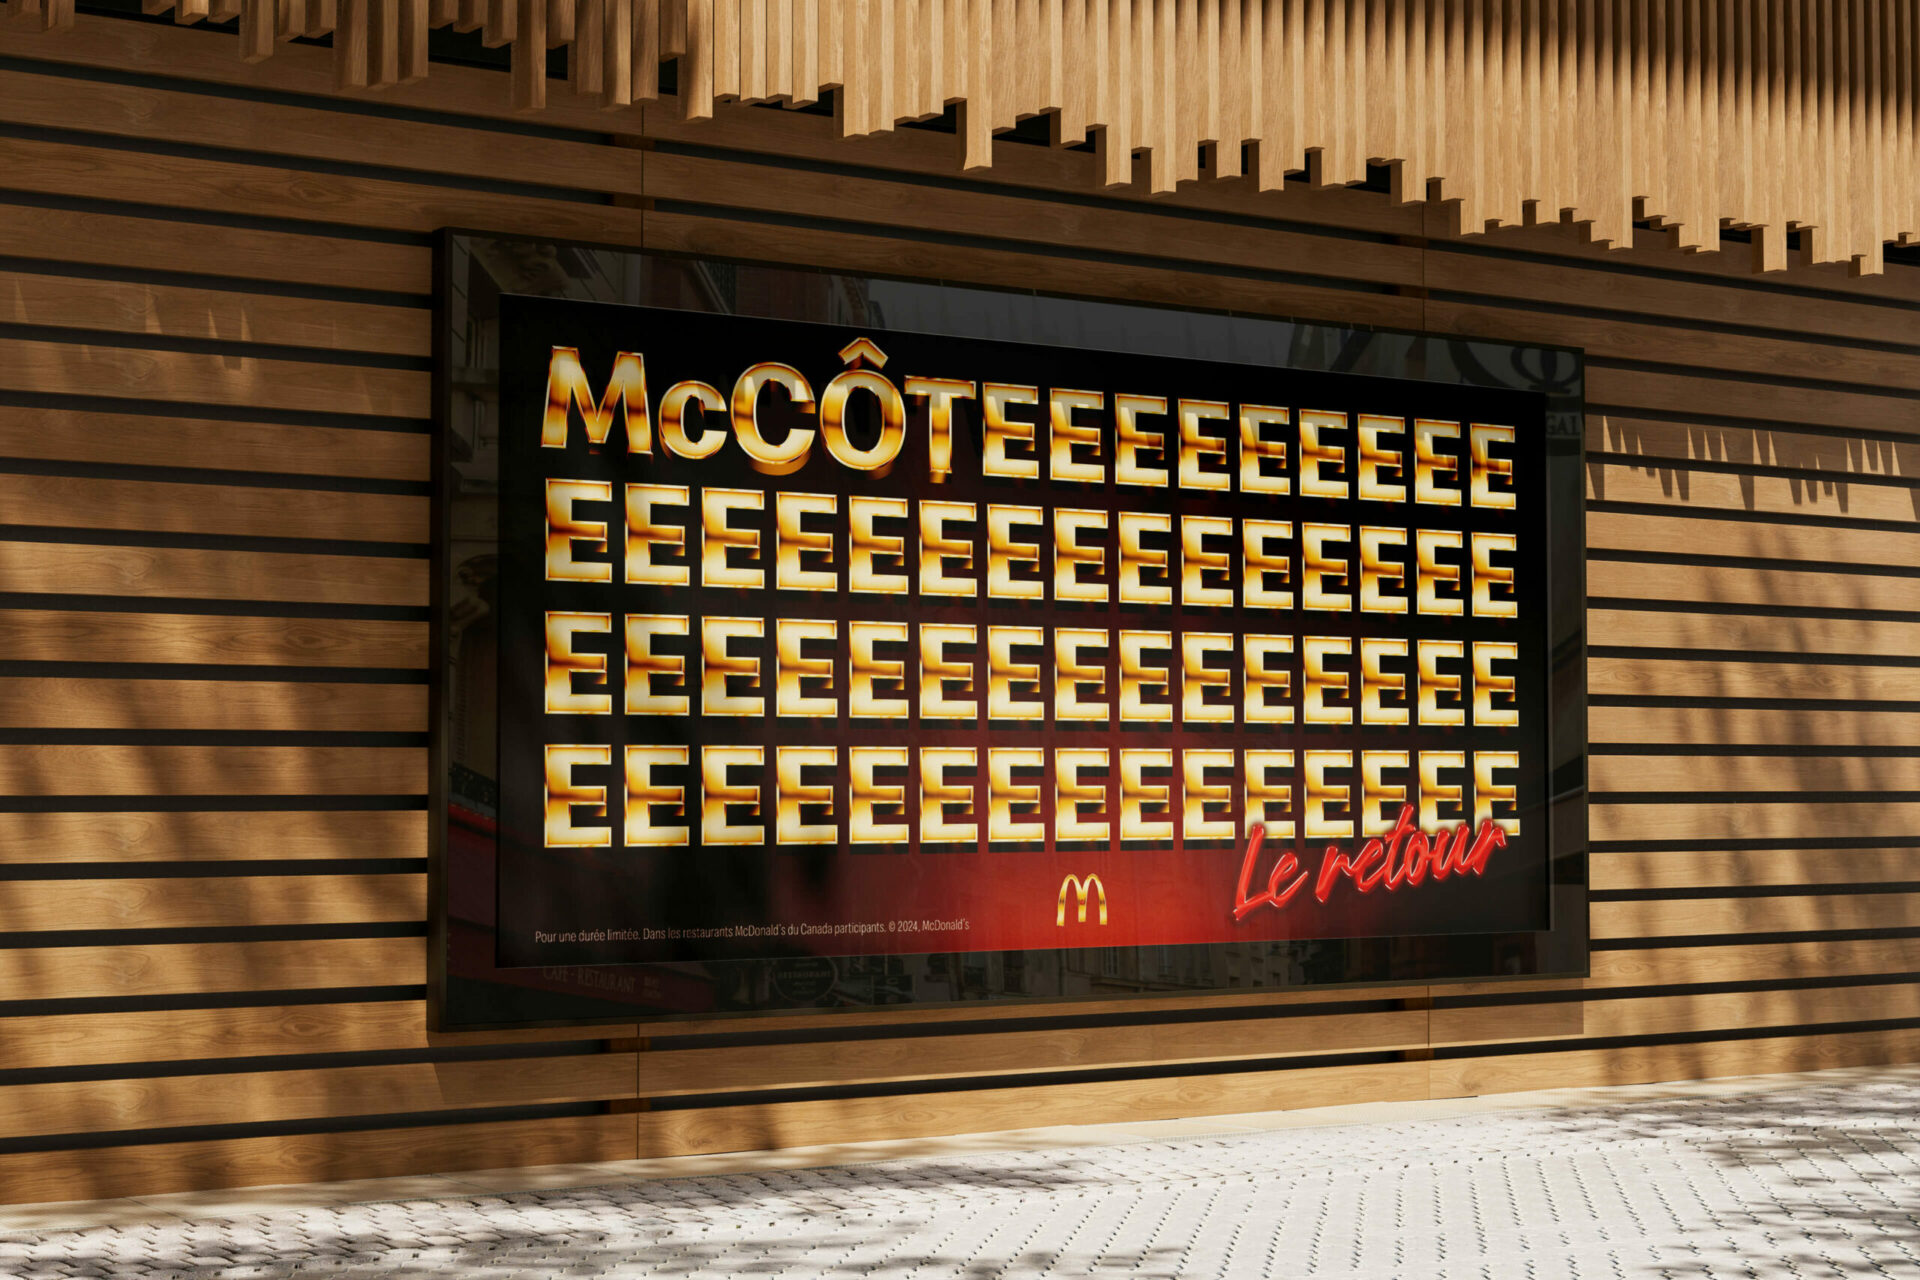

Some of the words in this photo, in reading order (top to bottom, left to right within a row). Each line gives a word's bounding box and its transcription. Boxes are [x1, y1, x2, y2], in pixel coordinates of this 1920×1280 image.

[541, 337, 1517, 510] McCÔTEEEEEEEEE
[545, 478, 1518, 619] EEEEEEEEEEEEEEE
[545, 610, 1519, 728] EEEEEEEEEEEEEEE
[1233, 823, 1308, 922] Le
[1315, 803, 1508, 902] retour
[535, 930, 556, 943] Pour
[558, 933, 577, 942] une
[578, 929, 606, 942] durée
[607, 928, 641, 941] limitée.
[643, 927, 666, 940] Dans
[667, 927, 681, 939] les
[682, 926, 733, 939] restaurants
[735, 923, 786, 937] McDonald's
[787, 924, 799, 935] du
[800, 922, 833, 935] Canada
[834, 921, 887, 936] participants.
[897, 920, 921, 933] 2024,
[922, 918, 970, 932] McDonald's
